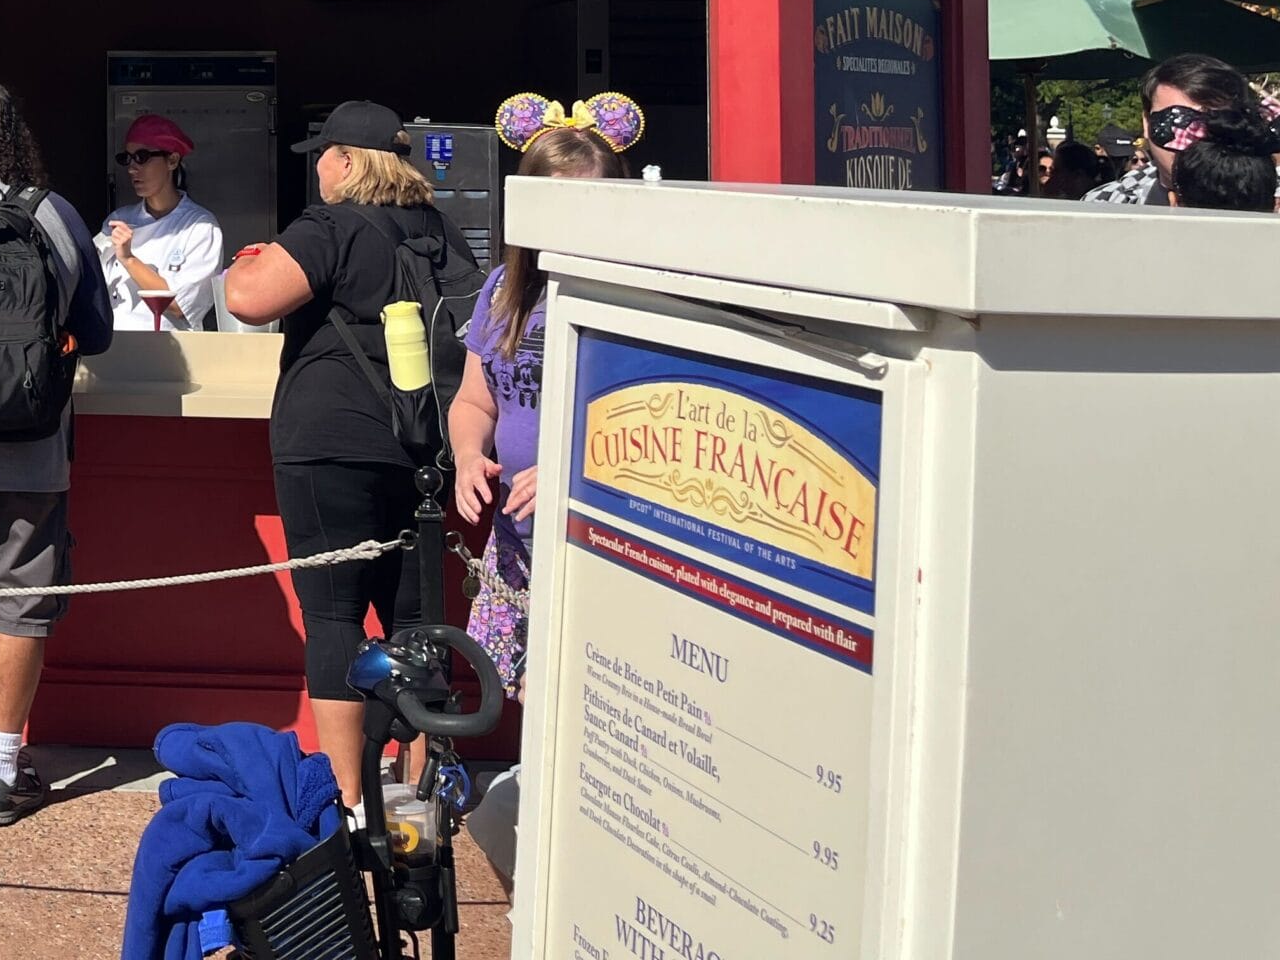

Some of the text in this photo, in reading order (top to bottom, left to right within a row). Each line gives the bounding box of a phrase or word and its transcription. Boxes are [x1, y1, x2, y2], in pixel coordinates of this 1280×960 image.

[825, 6, 926, 57] FAIT MAISON
[840, 125, 916, 153] TRADITIONNEL
[898, 157, 912, 190] DE
[676, 389, 757, 442] L'art de la
[590, 424, 866, 560] CUISINE FRANÇAISE
[653, 508, 705, 537] INTERNATIONAL
[707, 528, 740, 550] FESTIVAL
[744, 543, 754, 554] OF
[758, 546, 772, 561] THE
[775, 553, 797, 570] ARTS
[588, 527, 858, 652] Spectacular French cuisine, plated with elegance and prepared with flair
[585, 641, 703, 720] Crème de Brie en Petit Pain
[670, 633, 729, 683] MENU
[583, 683, 721, 783] Pithiviers de Canard et Volaille,
[584, 704, 639, 753] Sauce Canard
[579, 761, 662, 832] Escargot en Chocolat
[816, 764, 842, 793] 9.95
[813, 840, 839, 871] 9.95
[809, 912, 835, 945] 9.25
